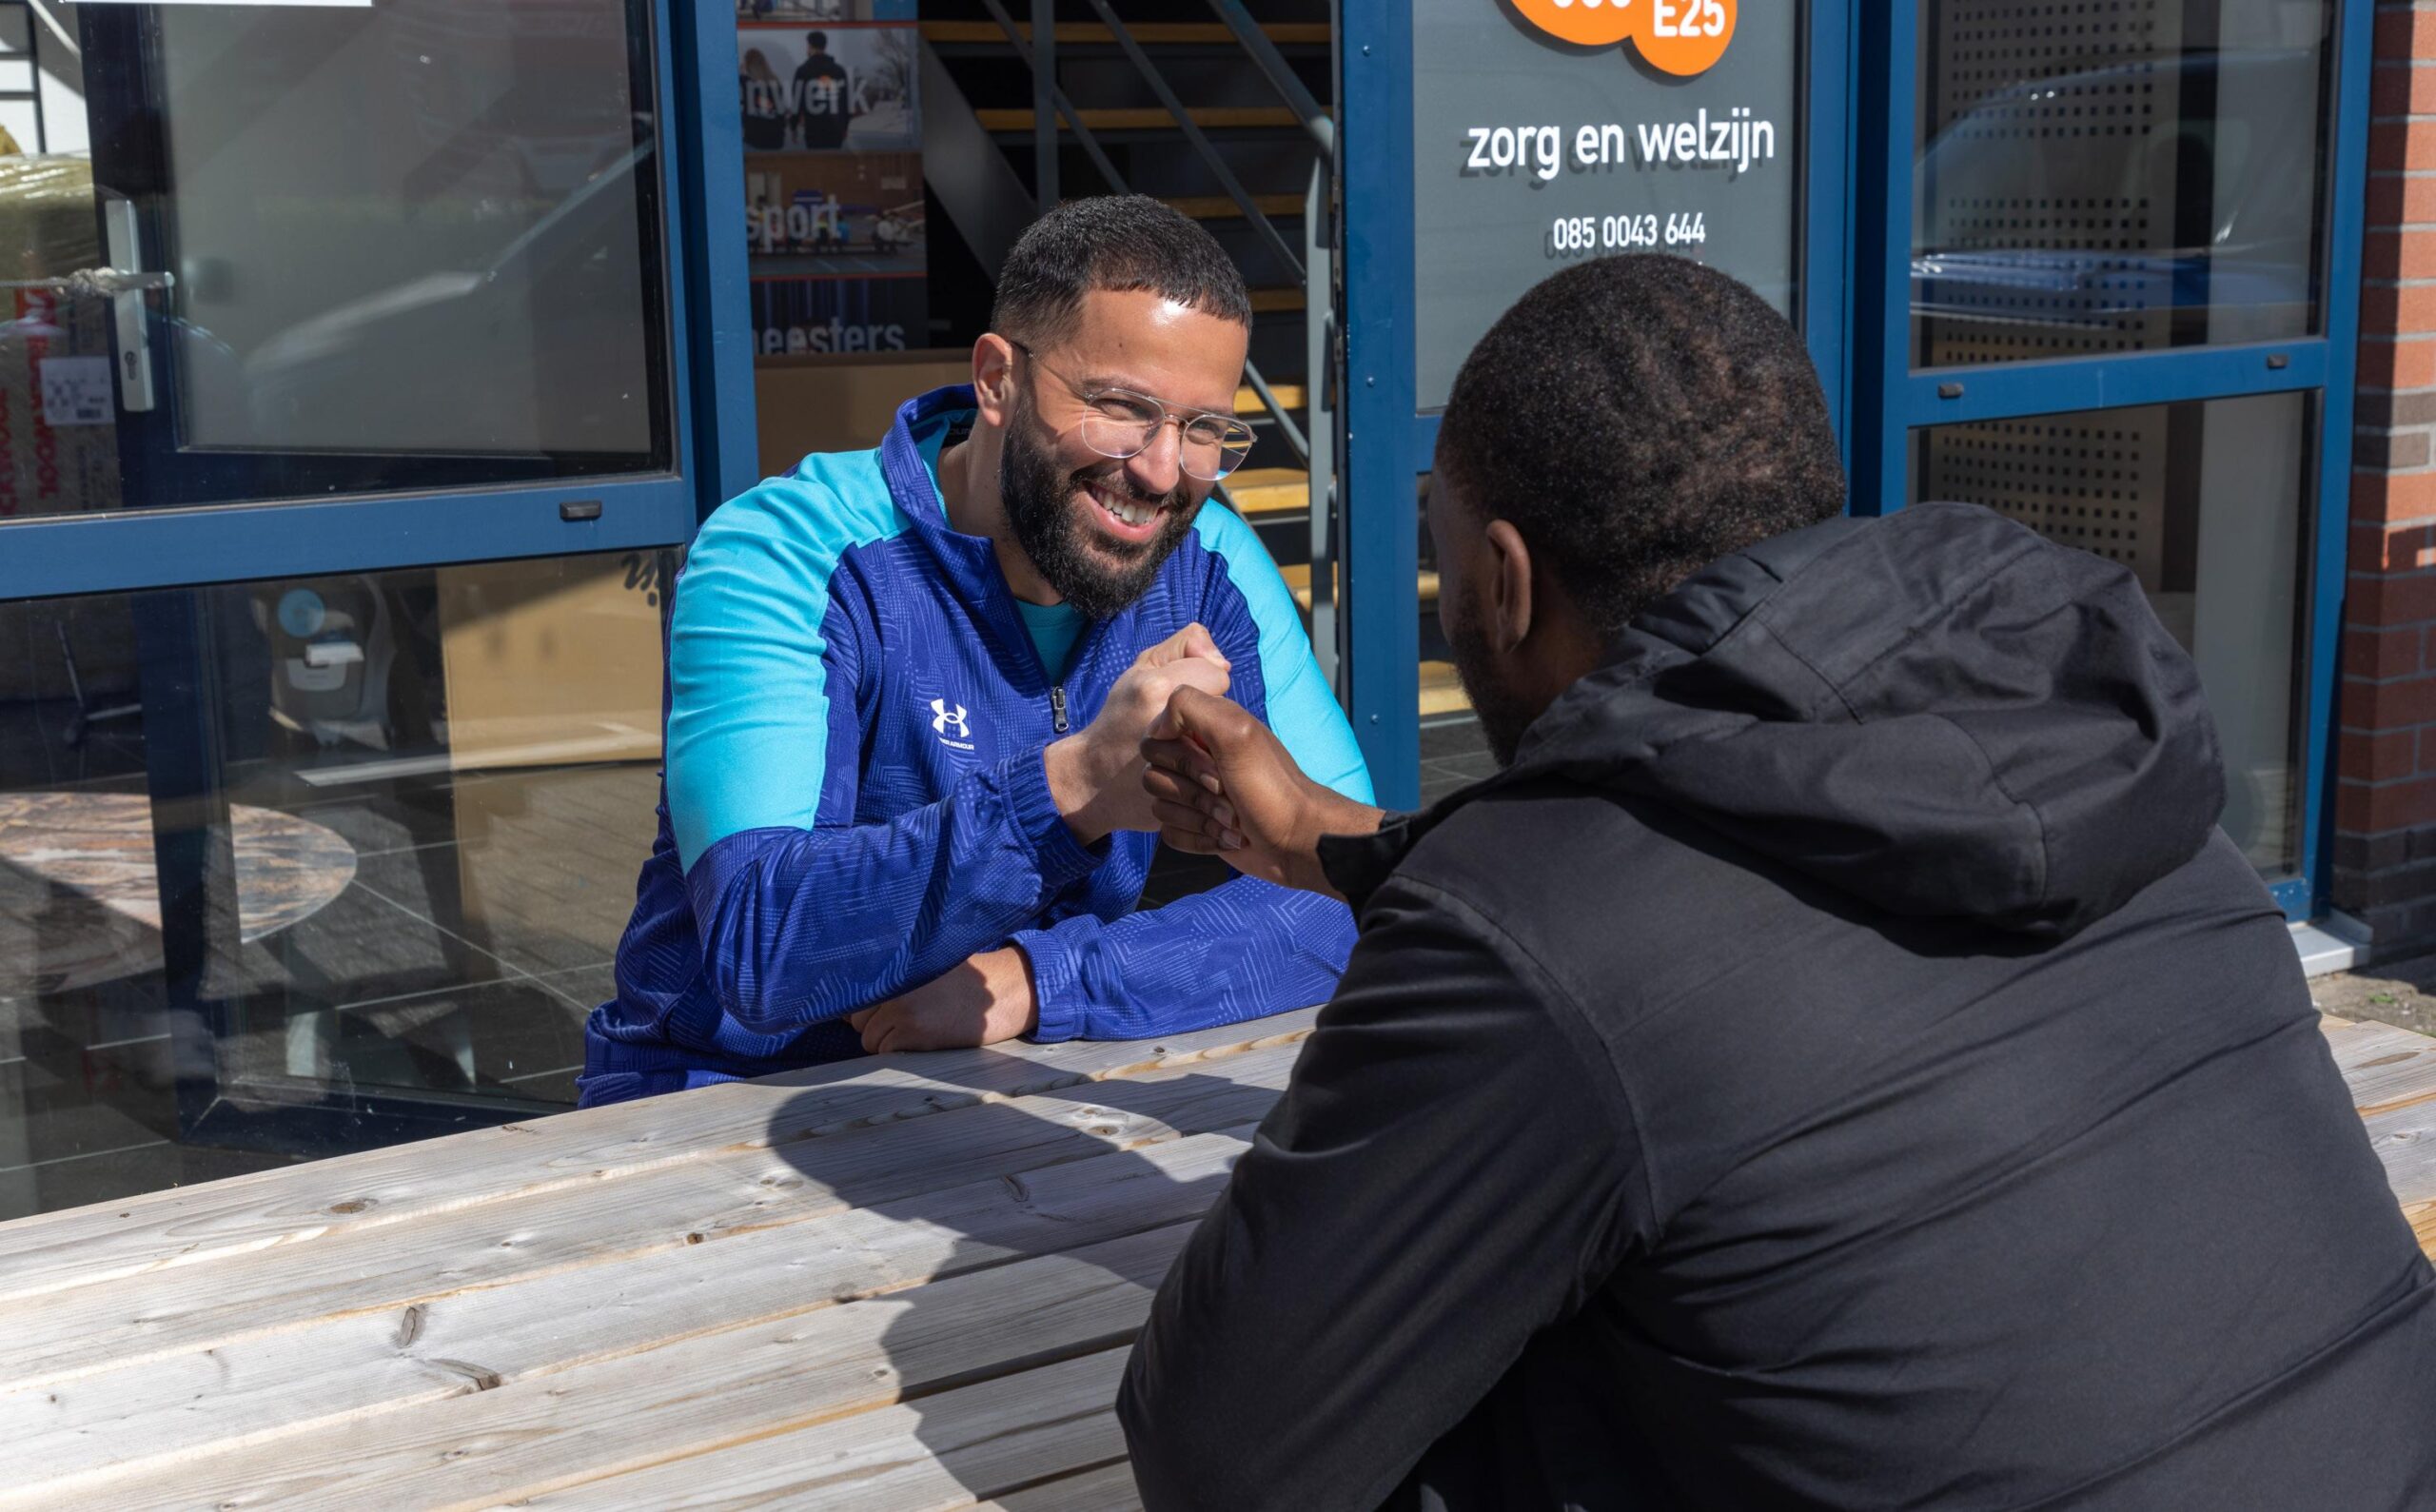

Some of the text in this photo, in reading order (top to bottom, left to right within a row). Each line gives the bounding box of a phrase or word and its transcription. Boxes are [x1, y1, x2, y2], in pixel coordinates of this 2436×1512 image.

[1653, 0, 1725, 37] E25
[739, 67, 871, 119] nwerk
[1467, 107, 1775, 181] zorg en welzijn
[1552, 211, 1706, 250] 085 0043 644
[753, 316, 906, 356] eesters
